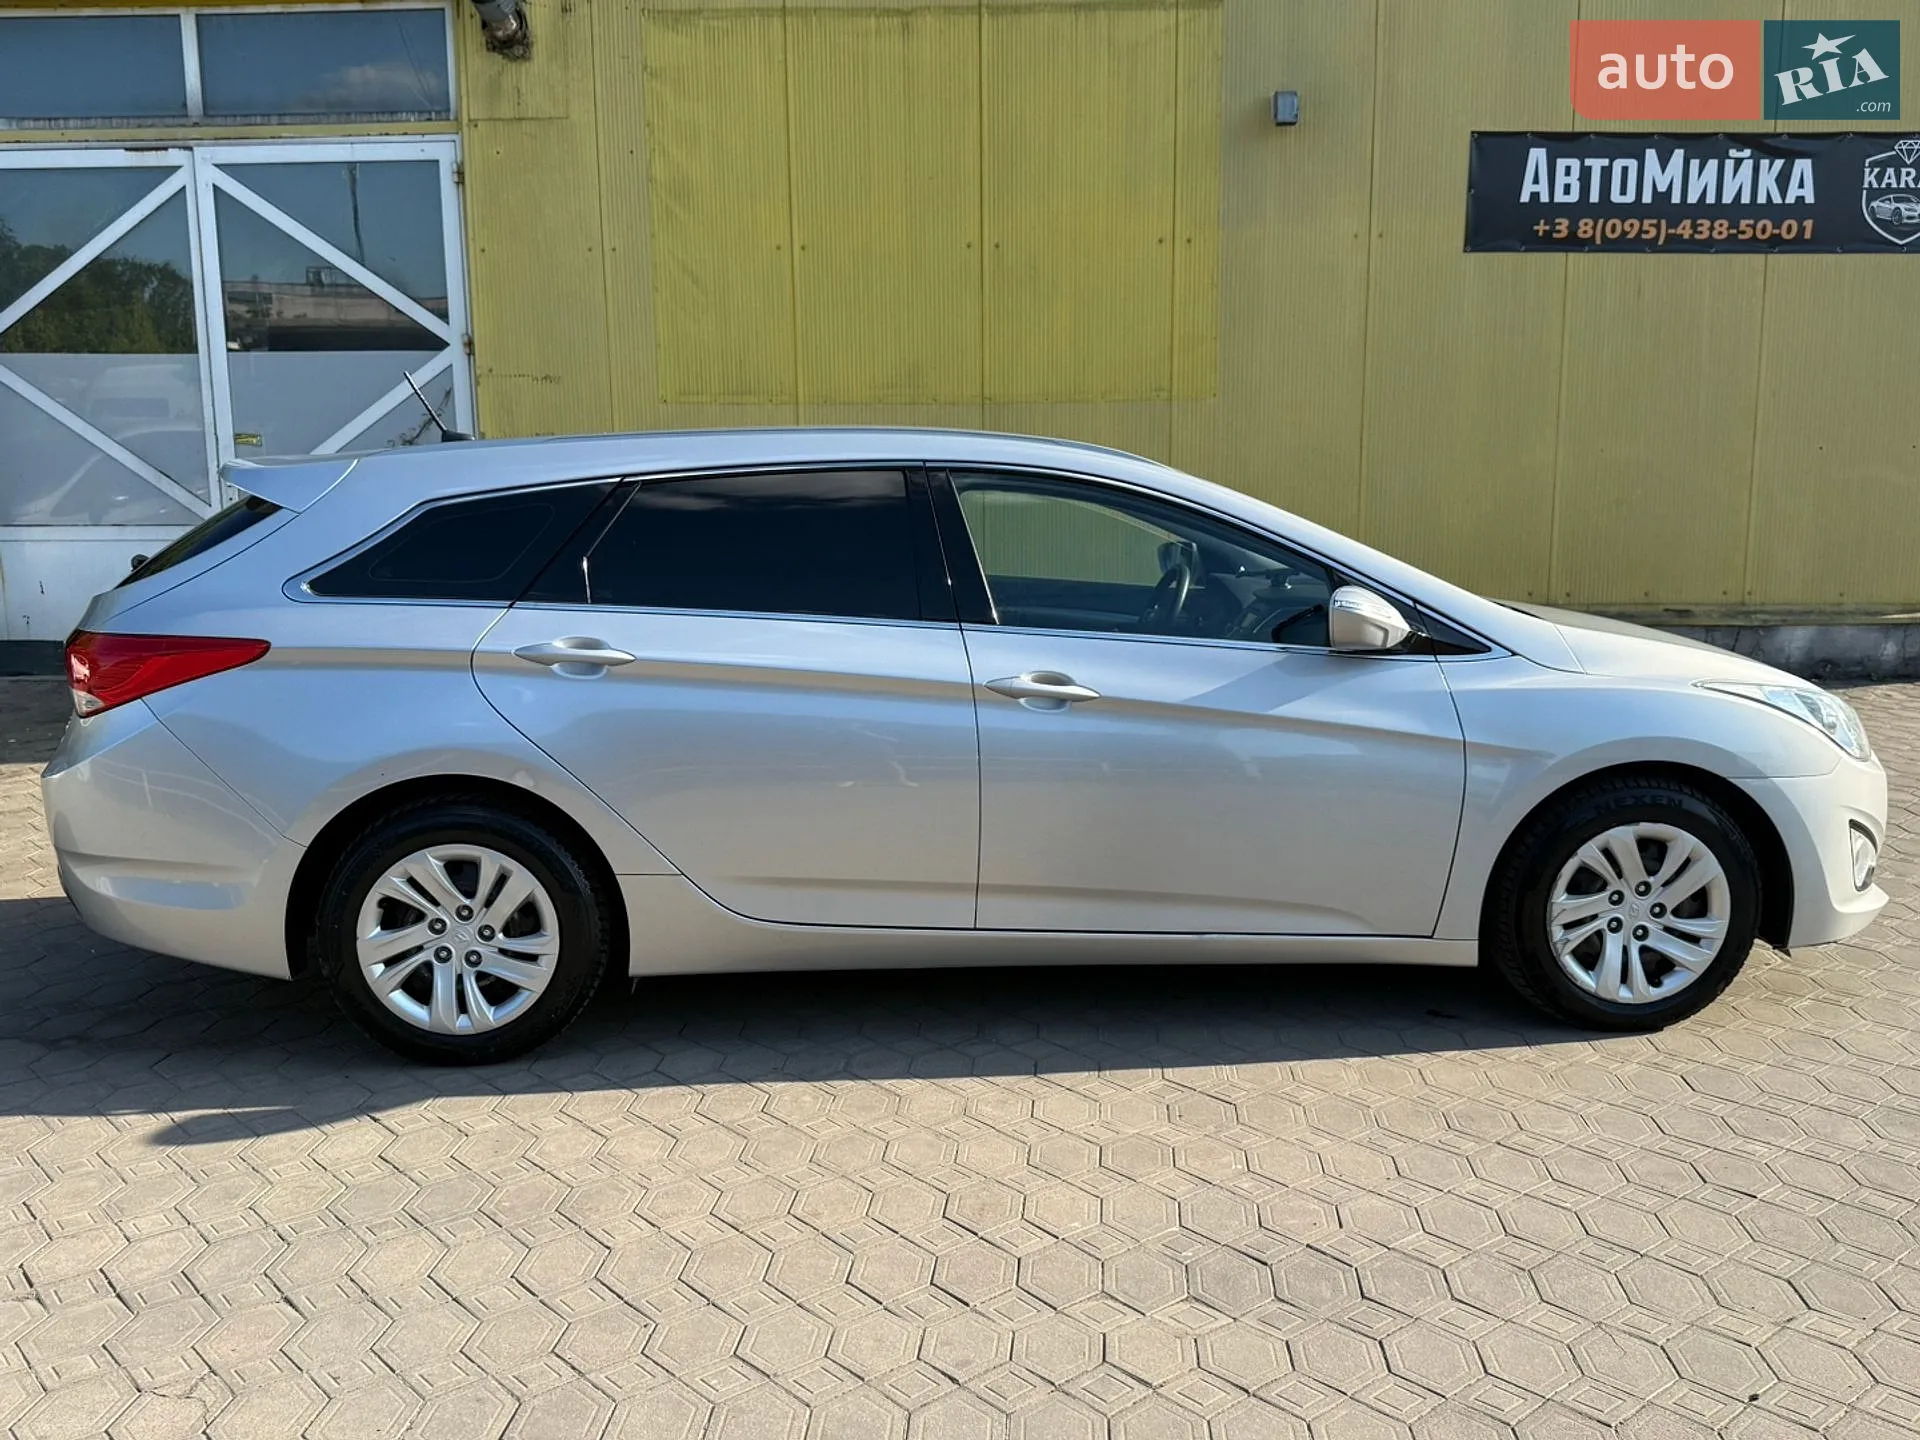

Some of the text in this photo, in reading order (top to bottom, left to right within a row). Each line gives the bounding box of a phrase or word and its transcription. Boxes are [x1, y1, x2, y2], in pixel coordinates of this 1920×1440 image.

[1863, 167, 1920, 188] KAR
[1576, 218, 1814, 245] 8(095)-438-50-01
[1594, 793, 1684, 814] NEXEN
